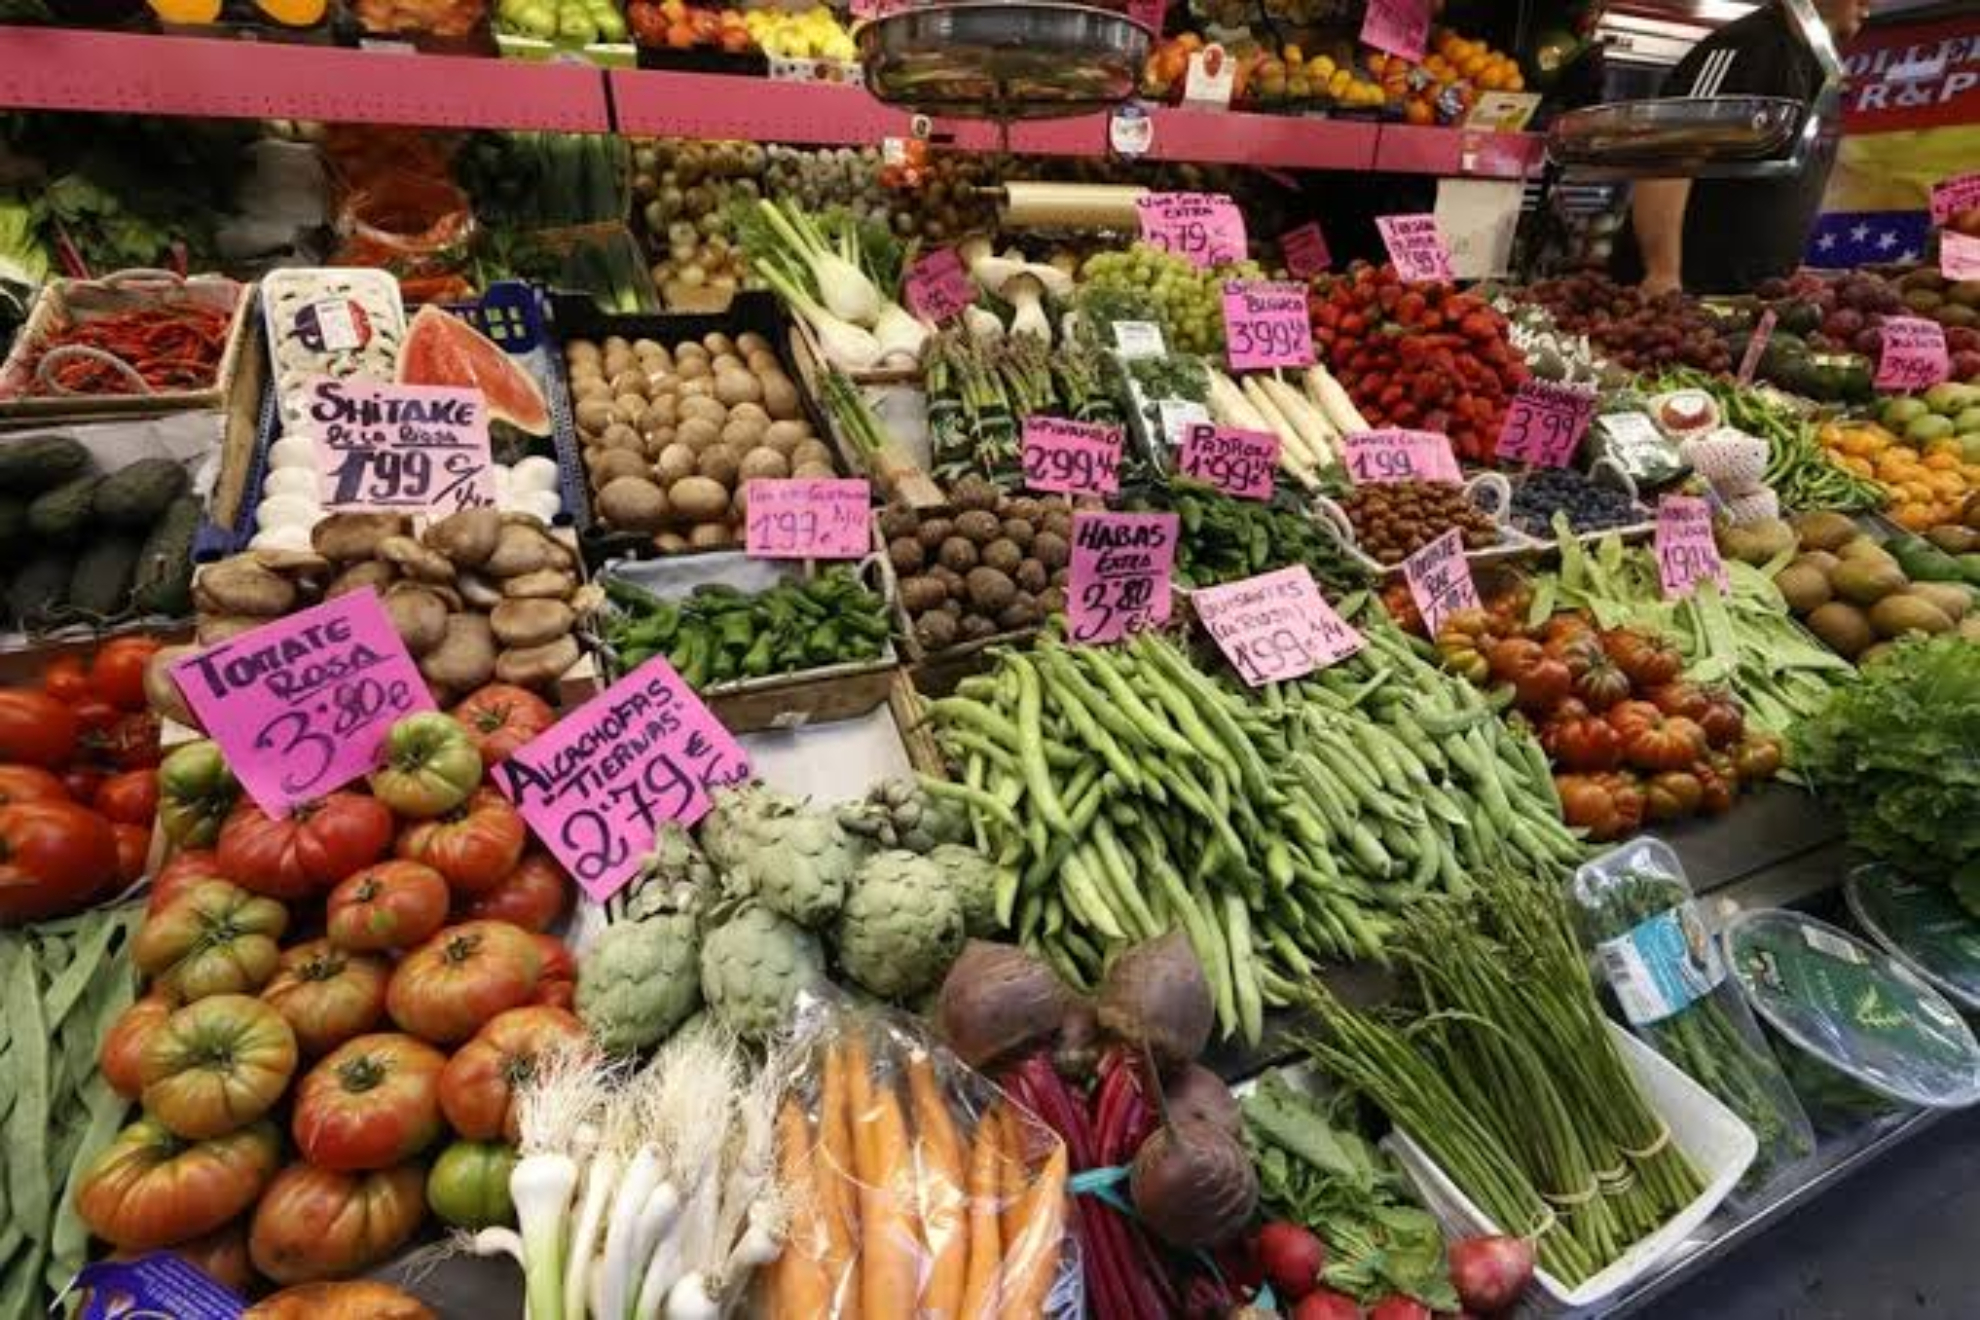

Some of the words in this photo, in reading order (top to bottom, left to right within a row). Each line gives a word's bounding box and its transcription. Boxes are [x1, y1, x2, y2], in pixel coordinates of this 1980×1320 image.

[1076, 519, 1167, 550] HABAS
[180, 616, 351, 700] TOMATE
[264, 643, 386, 701] ROSA
[502, 677, 673, 806] ALCACHOFAS
